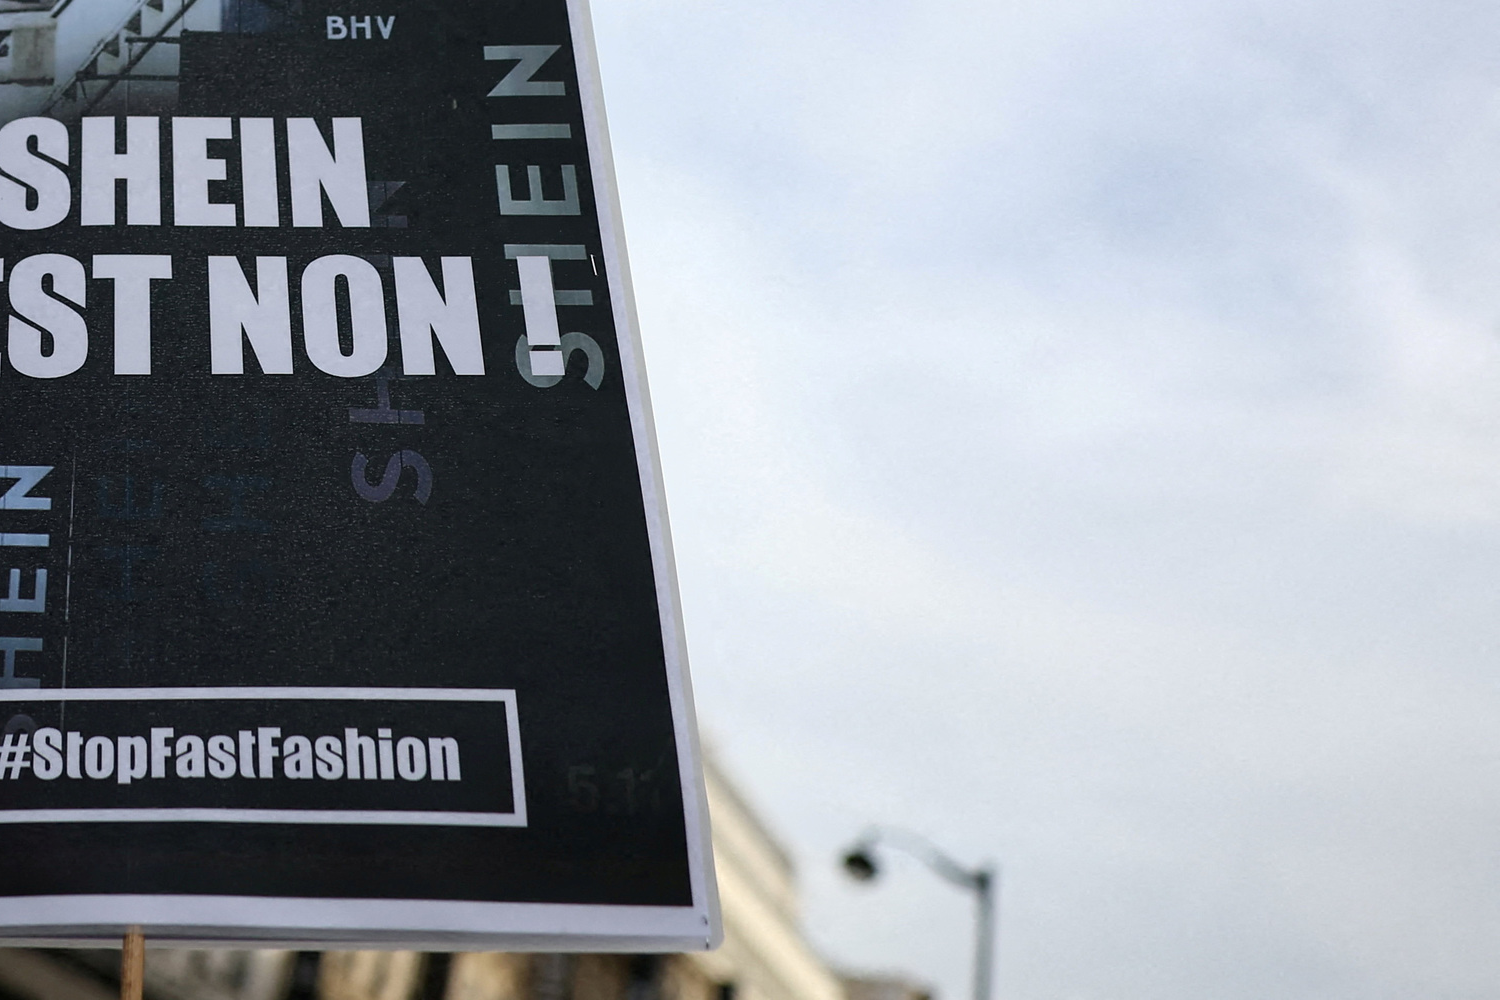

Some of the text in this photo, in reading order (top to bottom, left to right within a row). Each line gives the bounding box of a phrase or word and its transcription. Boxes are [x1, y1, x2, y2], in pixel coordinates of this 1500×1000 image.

[325, 14, 396, 41] BHV
[207, 254, 486, 379] NON
[516, 255, 565, 377] !
